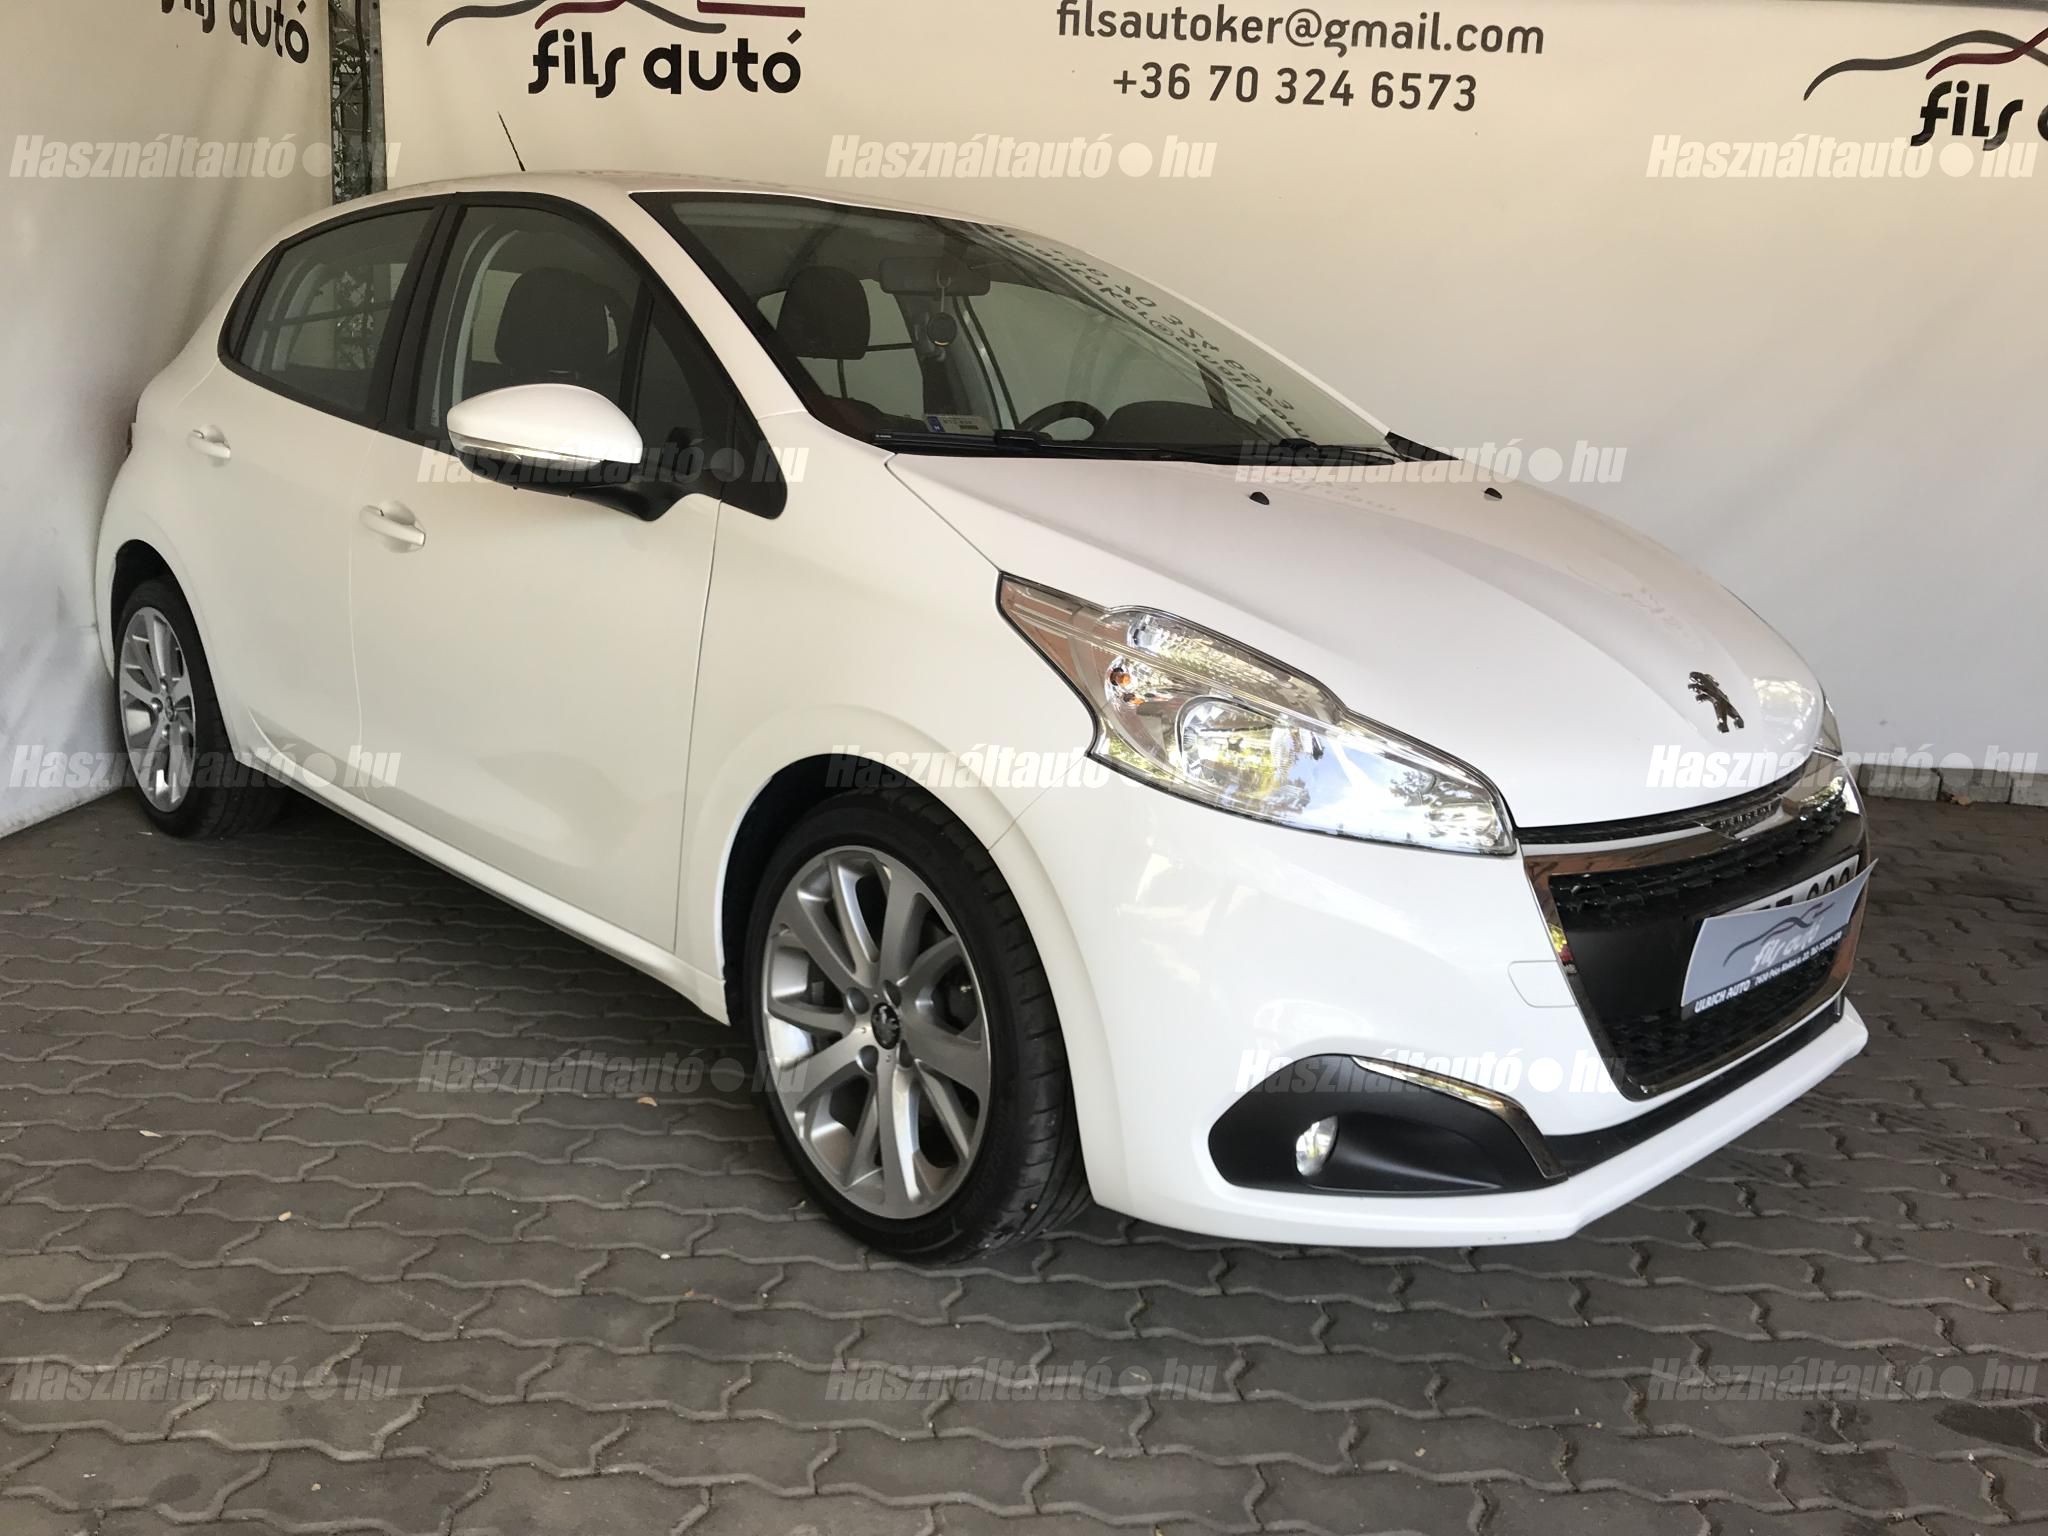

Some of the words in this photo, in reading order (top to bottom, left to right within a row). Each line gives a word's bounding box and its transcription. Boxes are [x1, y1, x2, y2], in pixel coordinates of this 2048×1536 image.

[229, 0, 310, 64] autó
[1056, 0, 1544, 58] filsautoker@gmail.com
[528, 29, 626, 98] fils
[642, 28, 802, 95] autó
[1112, 61, 1191, 100] +36
[1209, 65, 1259, 103] 70
[1274, 67, 1354, 107] 324
[1371, 71, 1477, 112] 6573
[1910, 79, 2024, 151] fils
